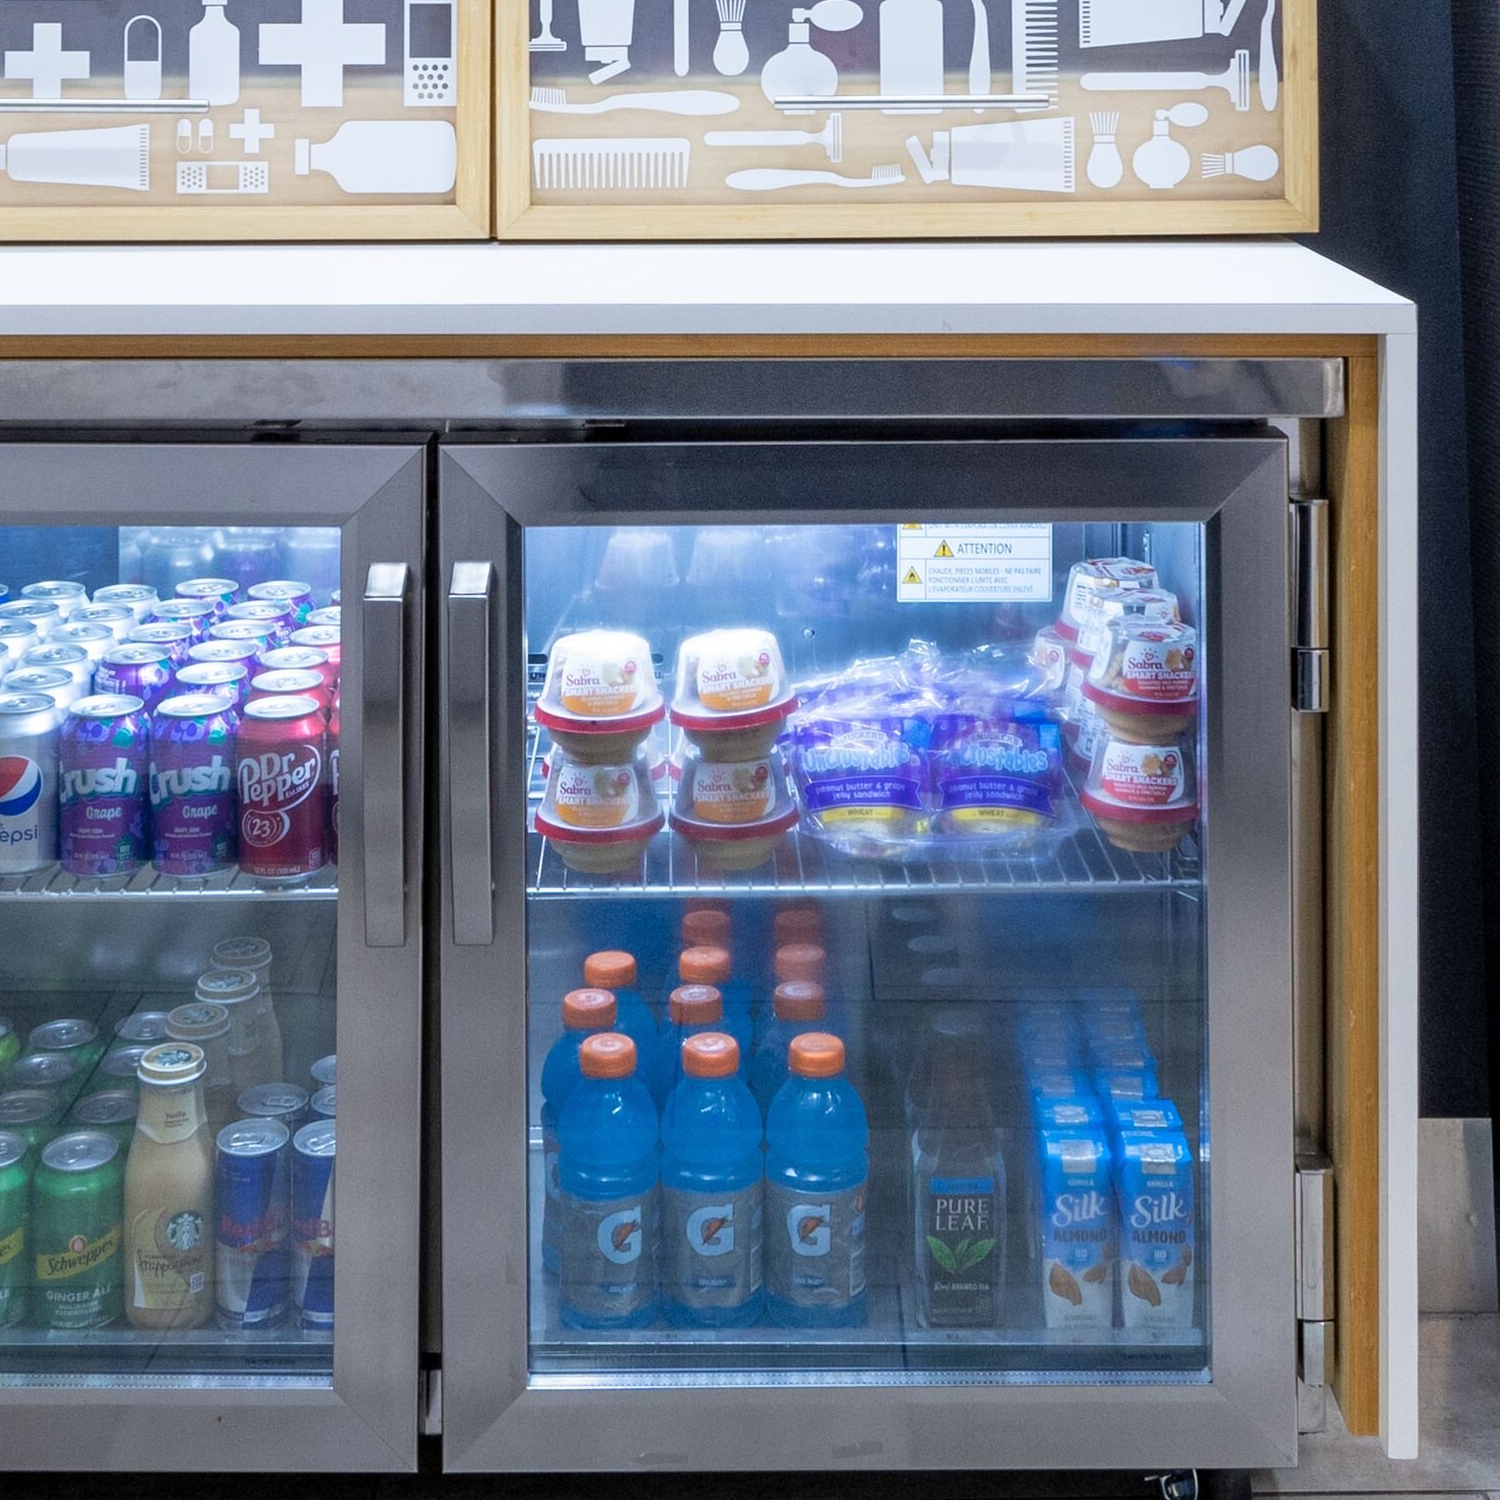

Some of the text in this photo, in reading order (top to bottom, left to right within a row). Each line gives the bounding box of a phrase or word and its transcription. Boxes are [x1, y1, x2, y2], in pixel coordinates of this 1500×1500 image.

[957, 543, 1012, 554] ATTENTION
[1128, 656, 1163, 670] Sabra
[566, 675, 600, 686] Sabra
[702, 672, 737, 684] Sabra
[259, 752, 295, 781] Dr
[1107, 760, 1140, 773] Sabra
[237, 758, 316, 805] Pepper
[560, 783, 591, 795] Sabra
[698, 781, 731, 792] Sabra
[816, 782, 874, 794] peanut butter
[979, 782, 1007, 791] butter
[833, 790, 891, 800] jelly sandwich
[86, 806, 122, 820] Grape
[182, 804, 218, 819] Grape
[252, 818, 271, 837] 23
[936, 1198, 989, 1214] PURE
[1052, 1190, 1109, 1228] Silk
[1131, 1192, 1187, 1228] Silk
[686, 1203, 734, 1257] G
[935, 1214, 988, 1231] LEAF
[597, 1204, 642, 1265] G
[787, 1204, 832, 1257] G
[46, 1284, 112, 1302] GINGER ALE
